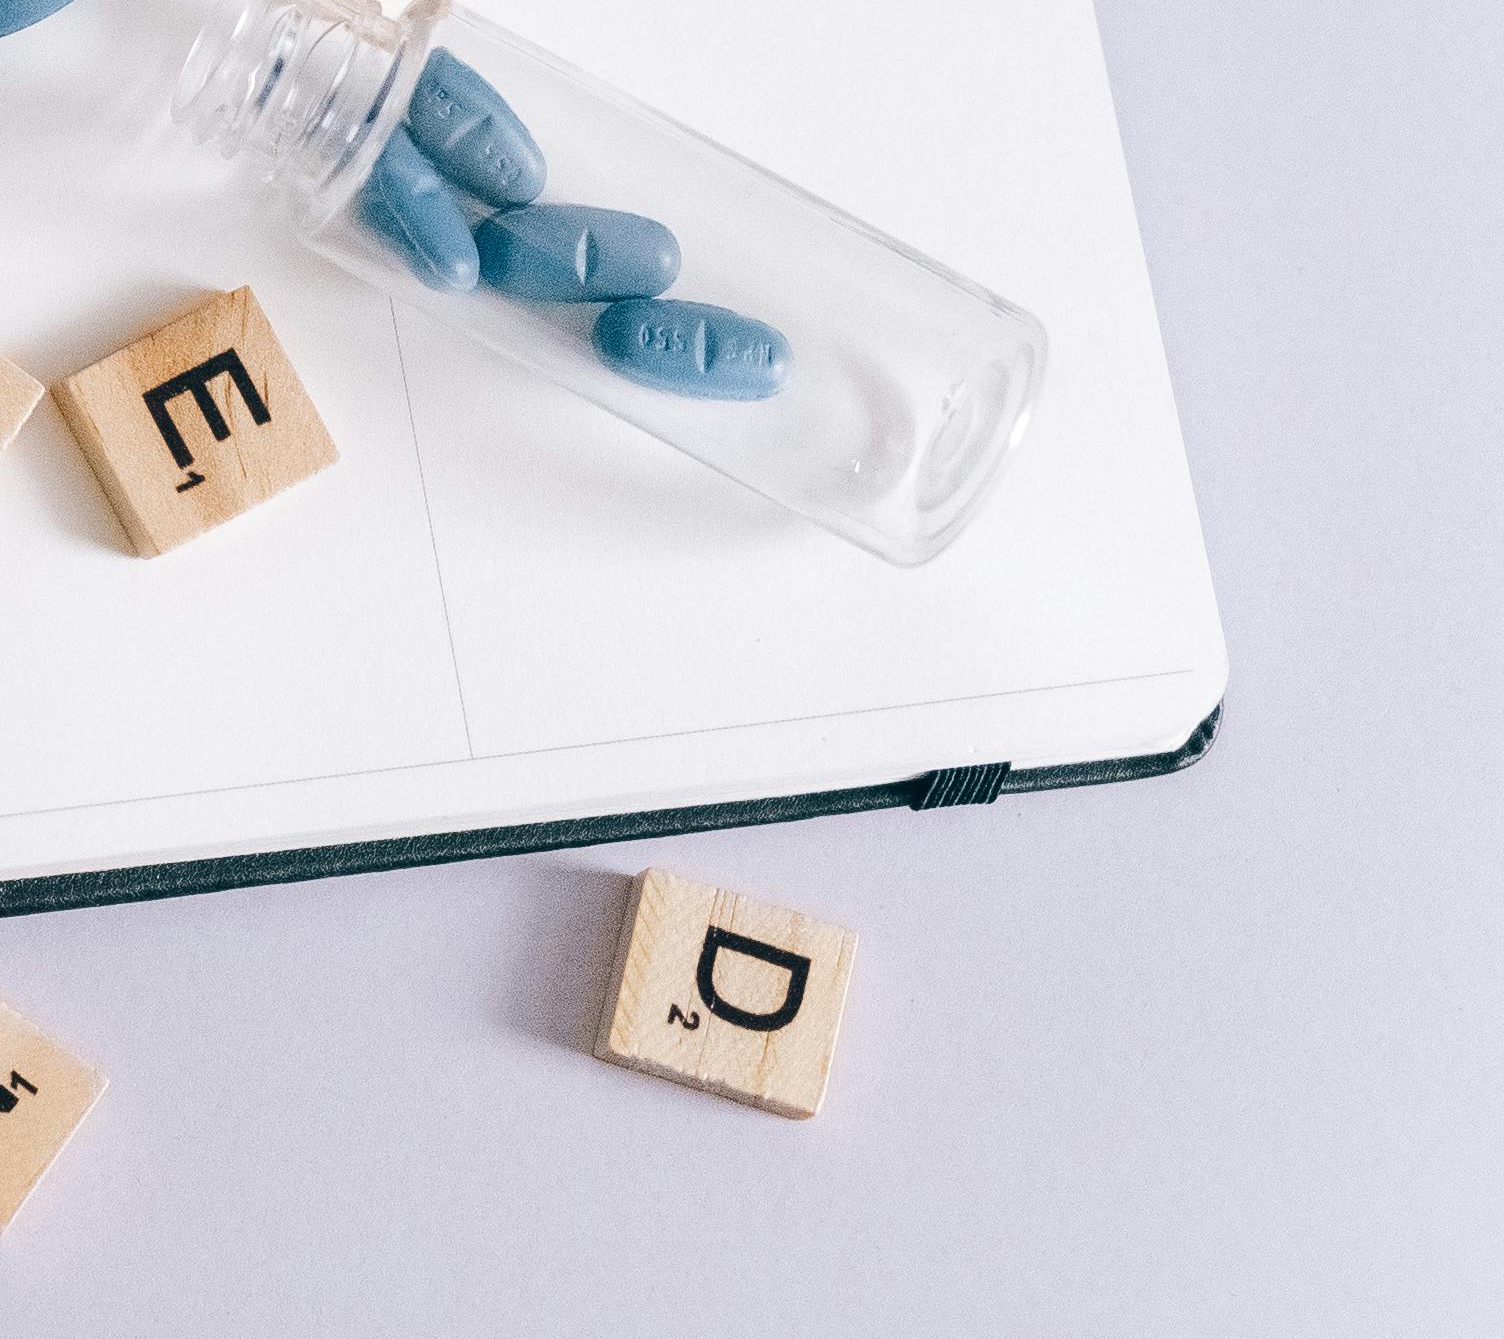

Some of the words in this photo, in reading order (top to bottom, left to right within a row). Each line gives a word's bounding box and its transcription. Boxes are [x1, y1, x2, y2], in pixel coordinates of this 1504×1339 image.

[142, 347, 271, 469] E
[176, 471, 206, 493] 1
[695, 925, 812, 1033] D
[667, 1004, 700, 1031] 2
[10, 1070, 38, 1095] 1
